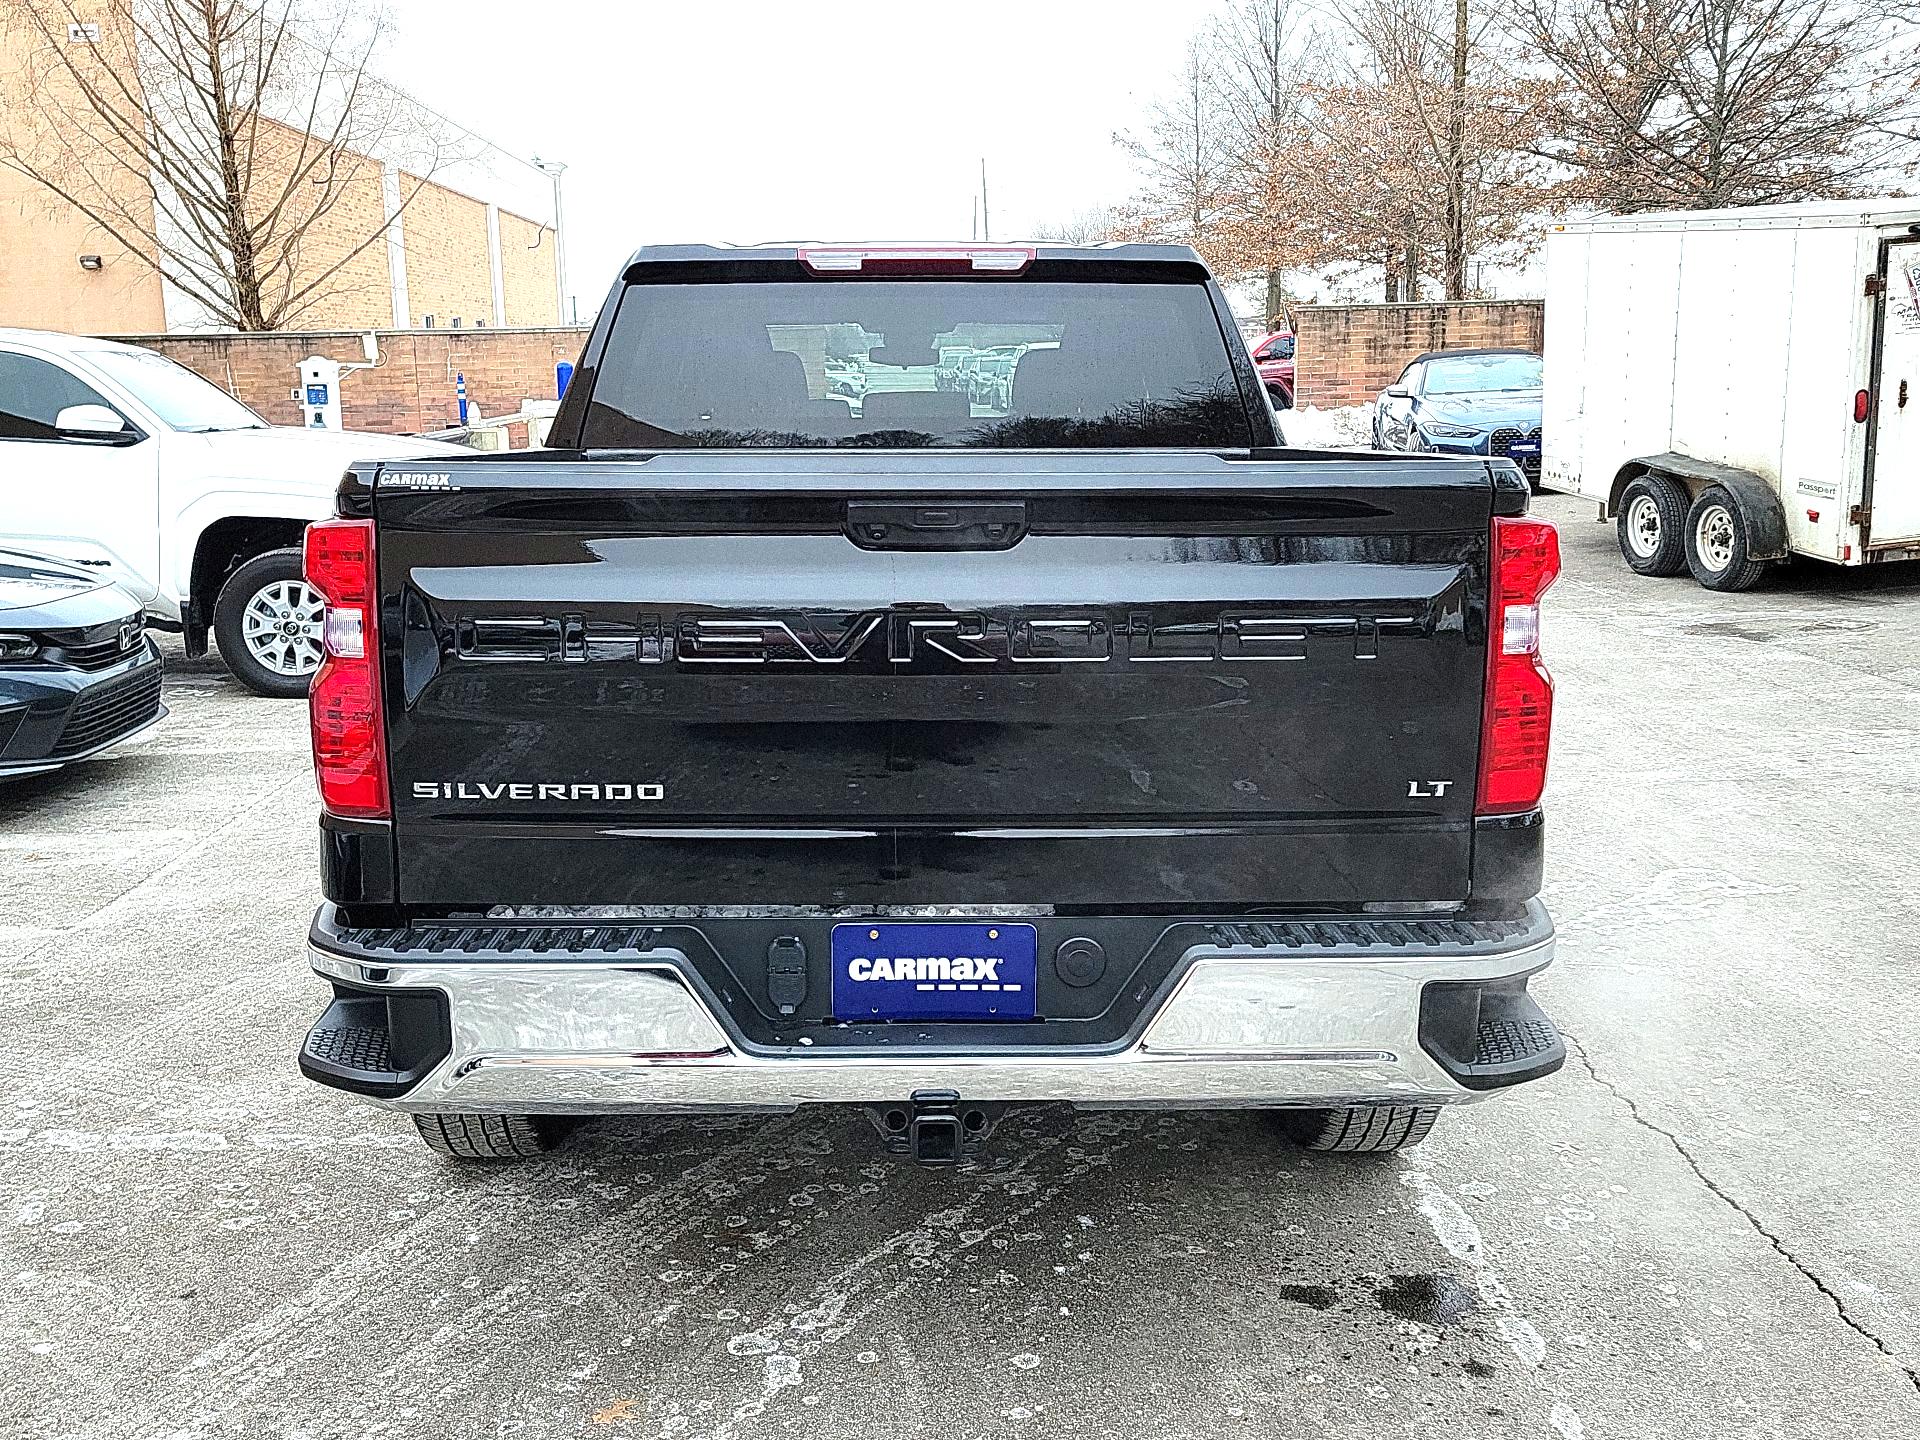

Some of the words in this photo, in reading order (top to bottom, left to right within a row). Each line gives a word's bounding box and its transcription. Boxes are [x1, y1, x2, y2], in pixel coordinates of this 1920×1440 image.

[380, 473, 451, 486] CARmax
[1799, 482, 1836, 495] Passport
[455, 611, 1415, 663] CHEVROLET
[412, 782, 665, 800] SILVERADO
[1407, 780, 1453, 797] LT
